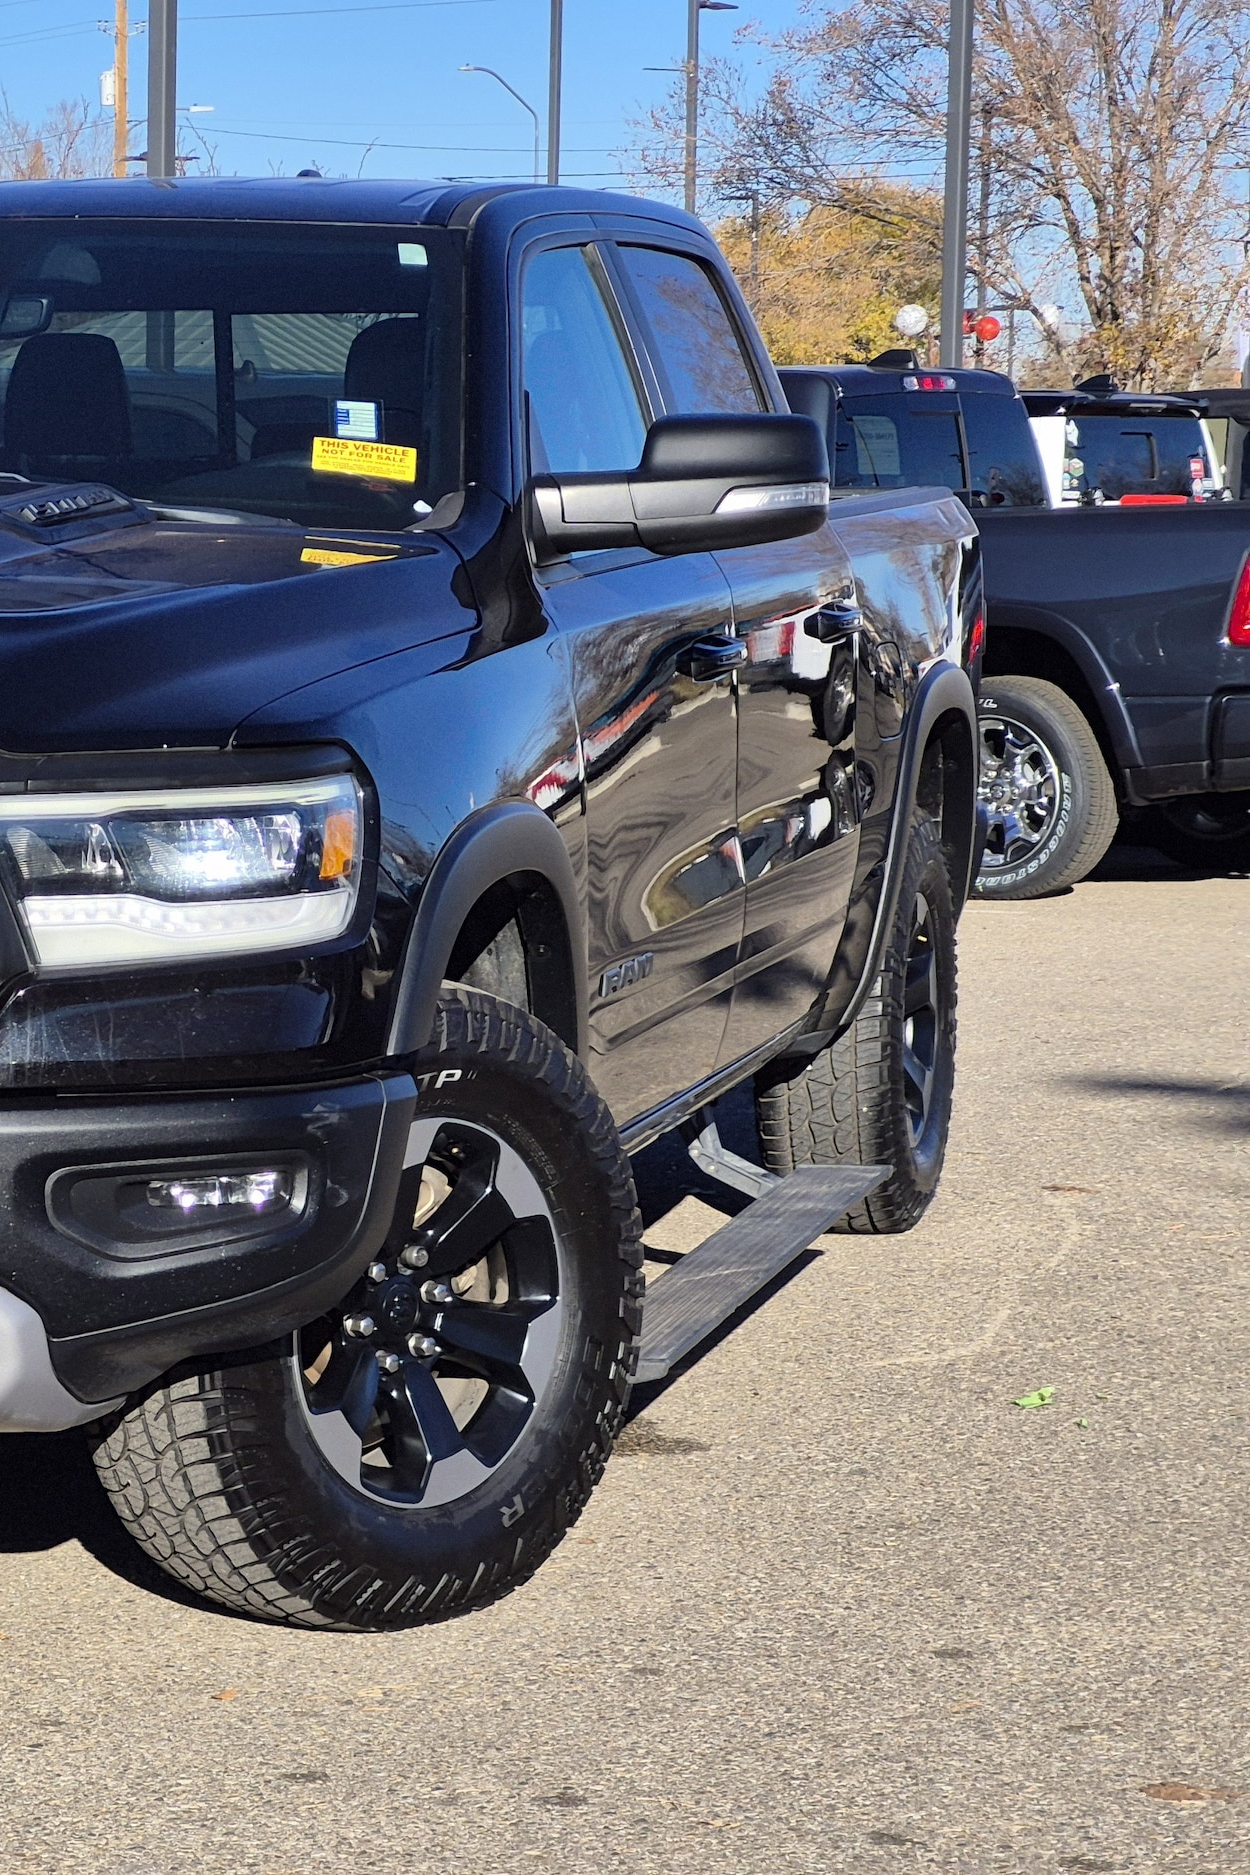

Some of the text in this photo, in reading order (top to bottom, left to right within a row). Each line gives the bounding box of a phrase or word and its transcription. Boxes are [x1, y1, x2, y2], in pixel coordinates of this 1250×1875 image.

[319, 440, 410, 458] THIS VEHICLE
[322, 448, 344, 456] NOT
[349, 451, 373, 459] FOR
[376, 454, 407, 464] SALE
[598, 952, 654, 998] RAM
